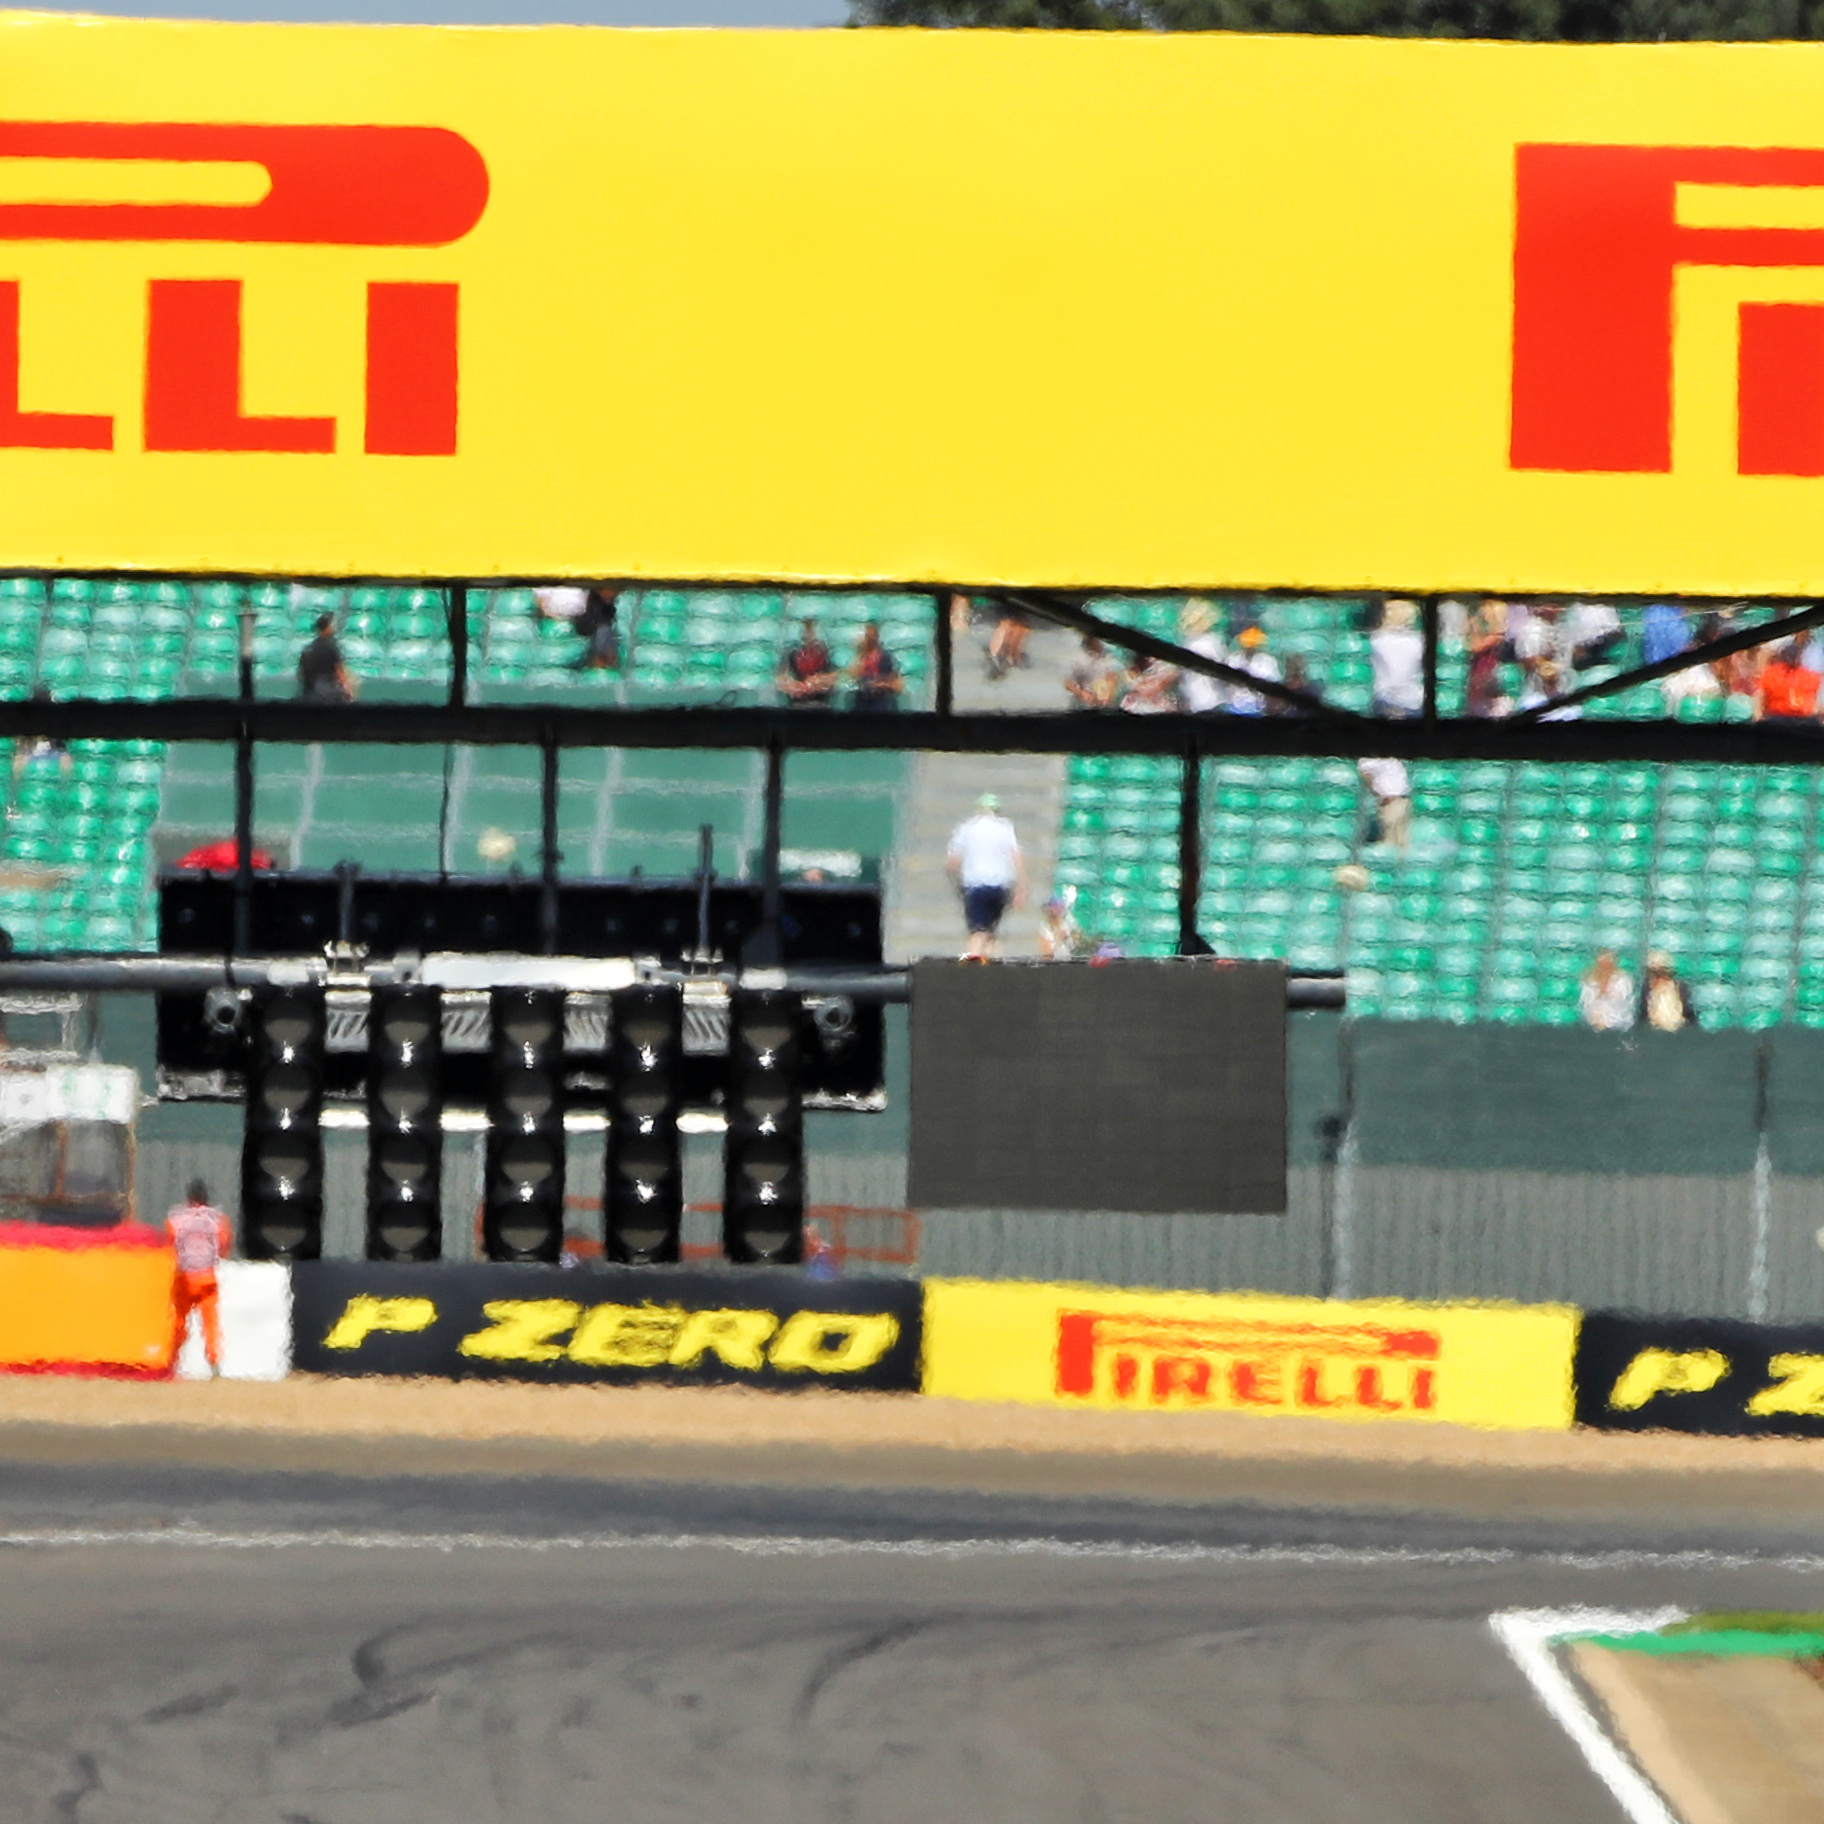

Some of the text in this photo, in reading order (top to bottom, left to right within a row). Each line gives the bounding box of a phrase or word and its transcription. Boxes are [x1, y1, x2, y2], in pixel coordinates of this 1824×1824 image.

[322, 1293, 900, 1374] P ZERO
[1057, 1308, 1441, 1410] PIRELLI
[1609, 1346, 1730, 1410] P
